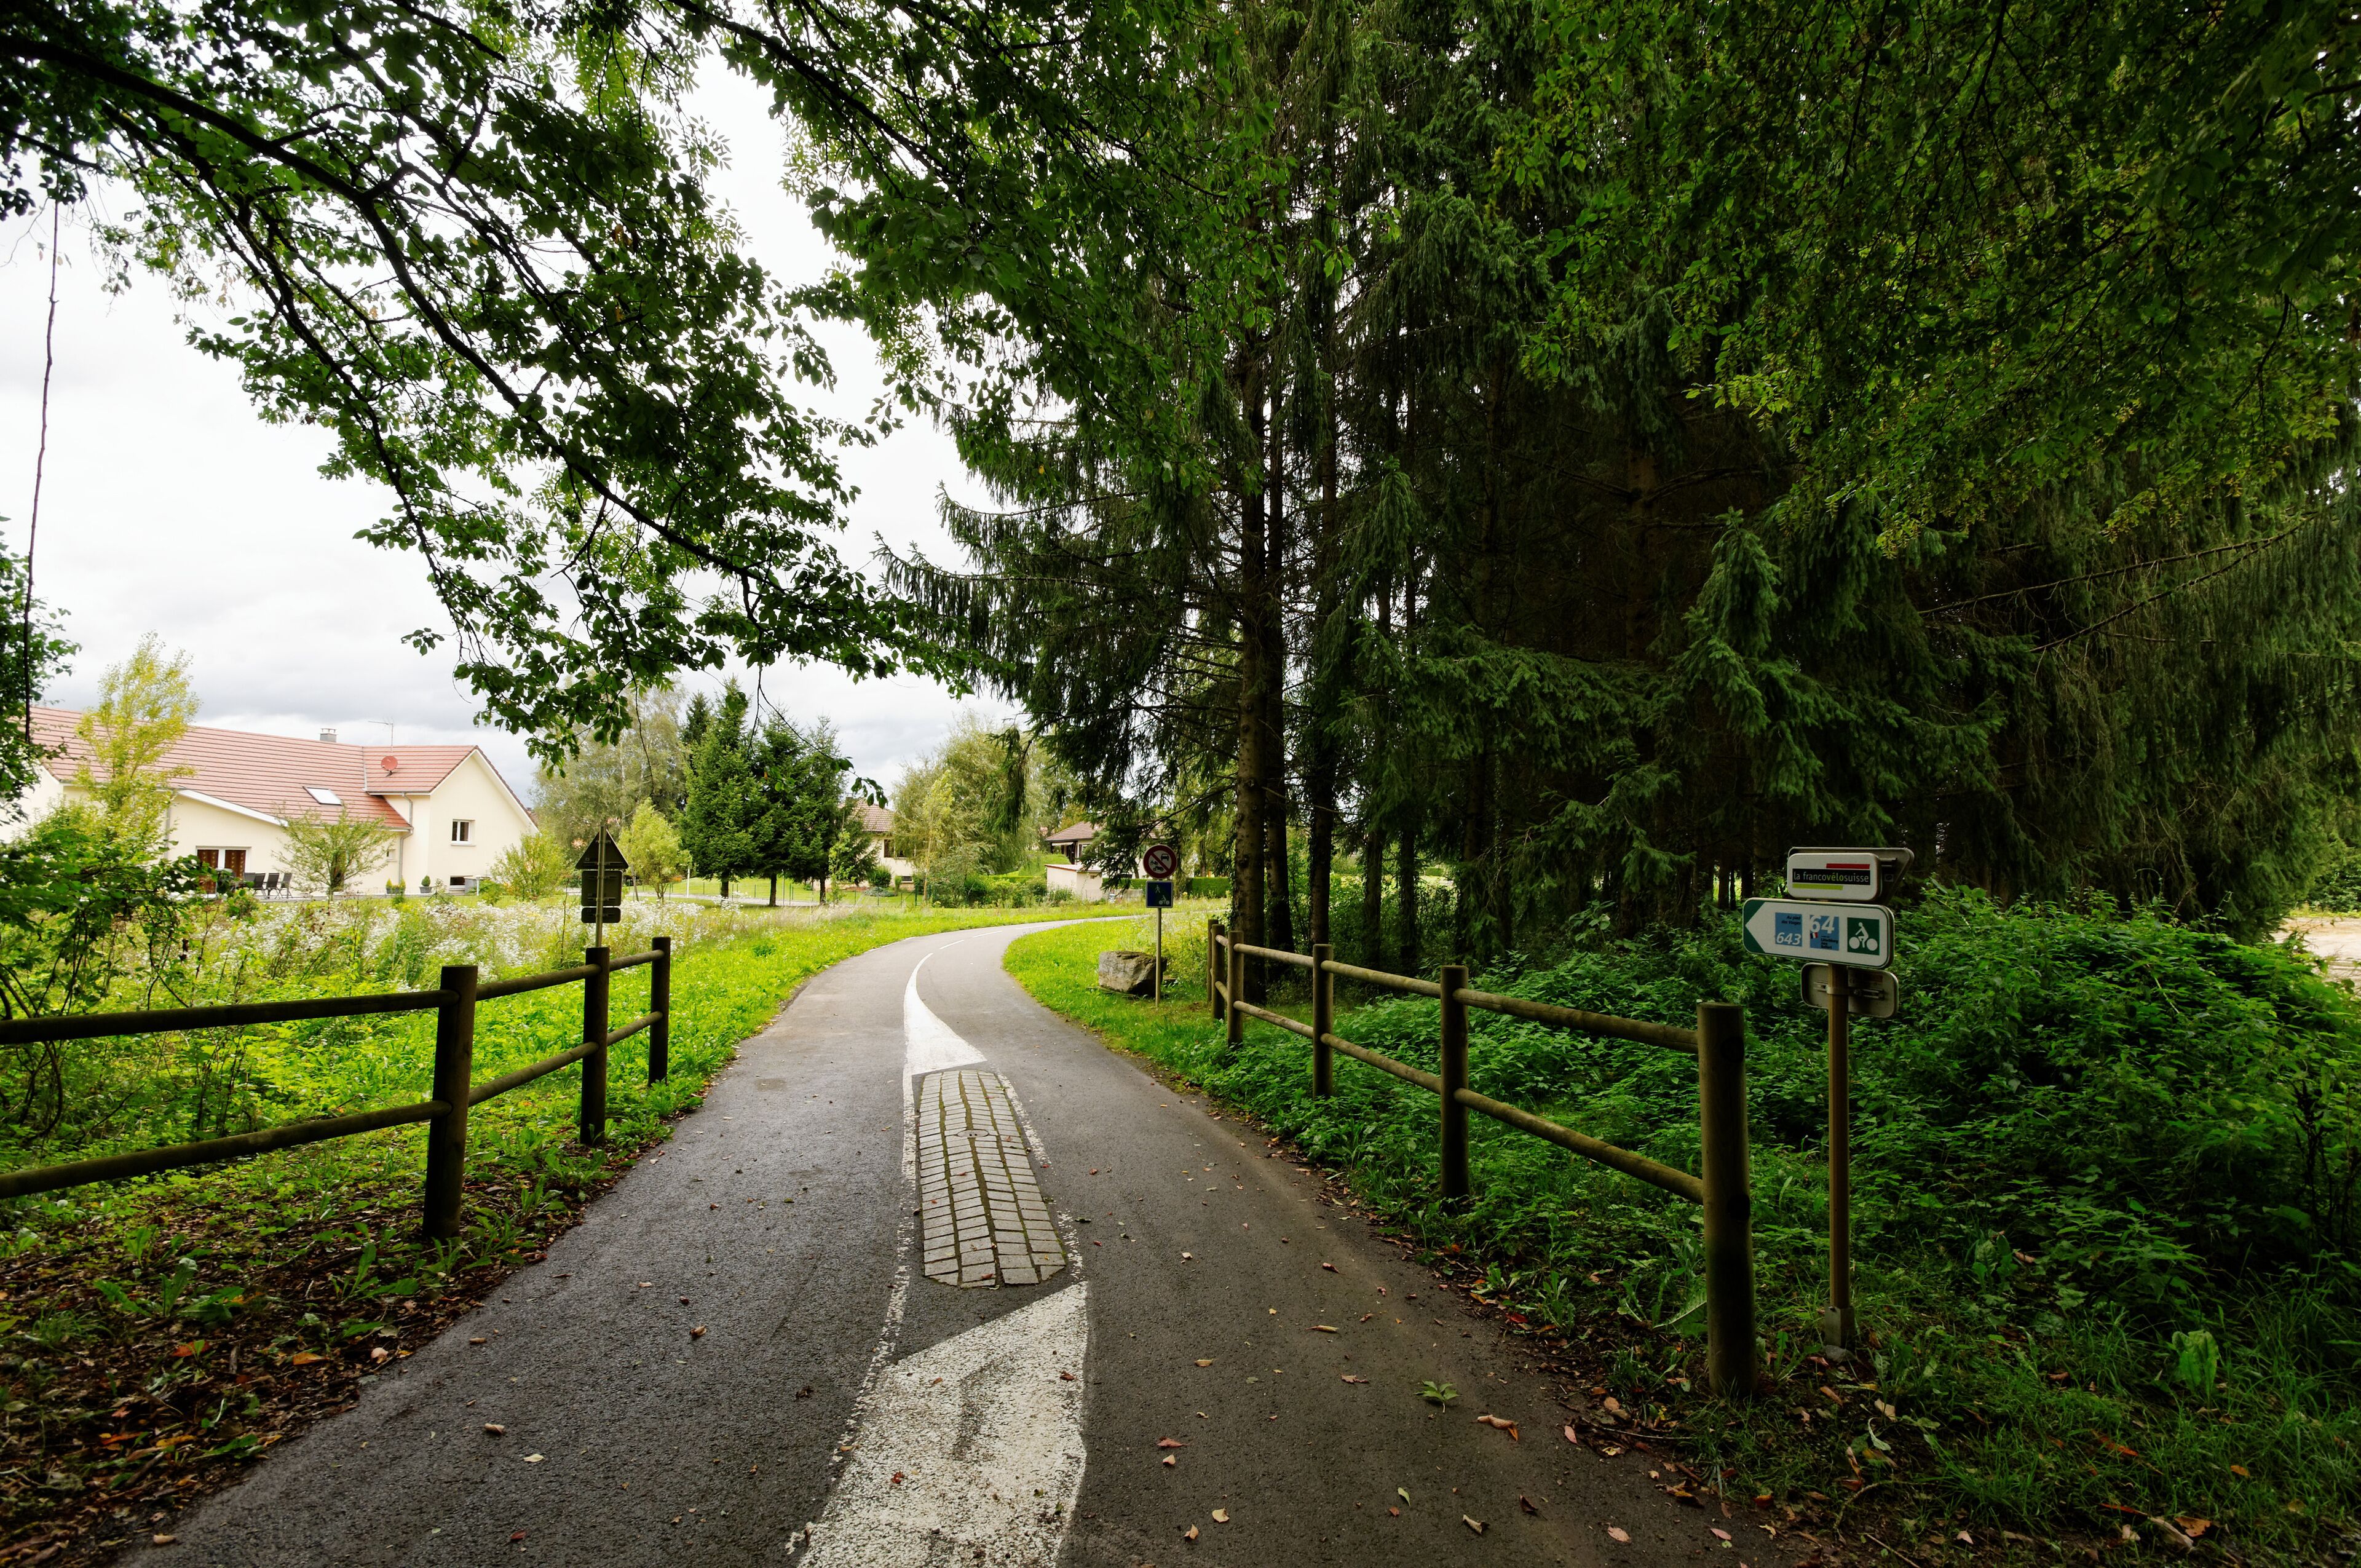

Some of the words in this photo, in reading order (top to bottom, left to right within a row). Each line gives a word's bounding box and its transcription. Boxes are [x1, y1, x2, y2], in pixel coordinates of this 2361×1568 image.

[1793, 871, 1800, 880] la
[1803, 872, 1869, 882] francovélosuisse
[1809, 915, 1835, 934] 64
[1776, 932, 1801, 945] 643
